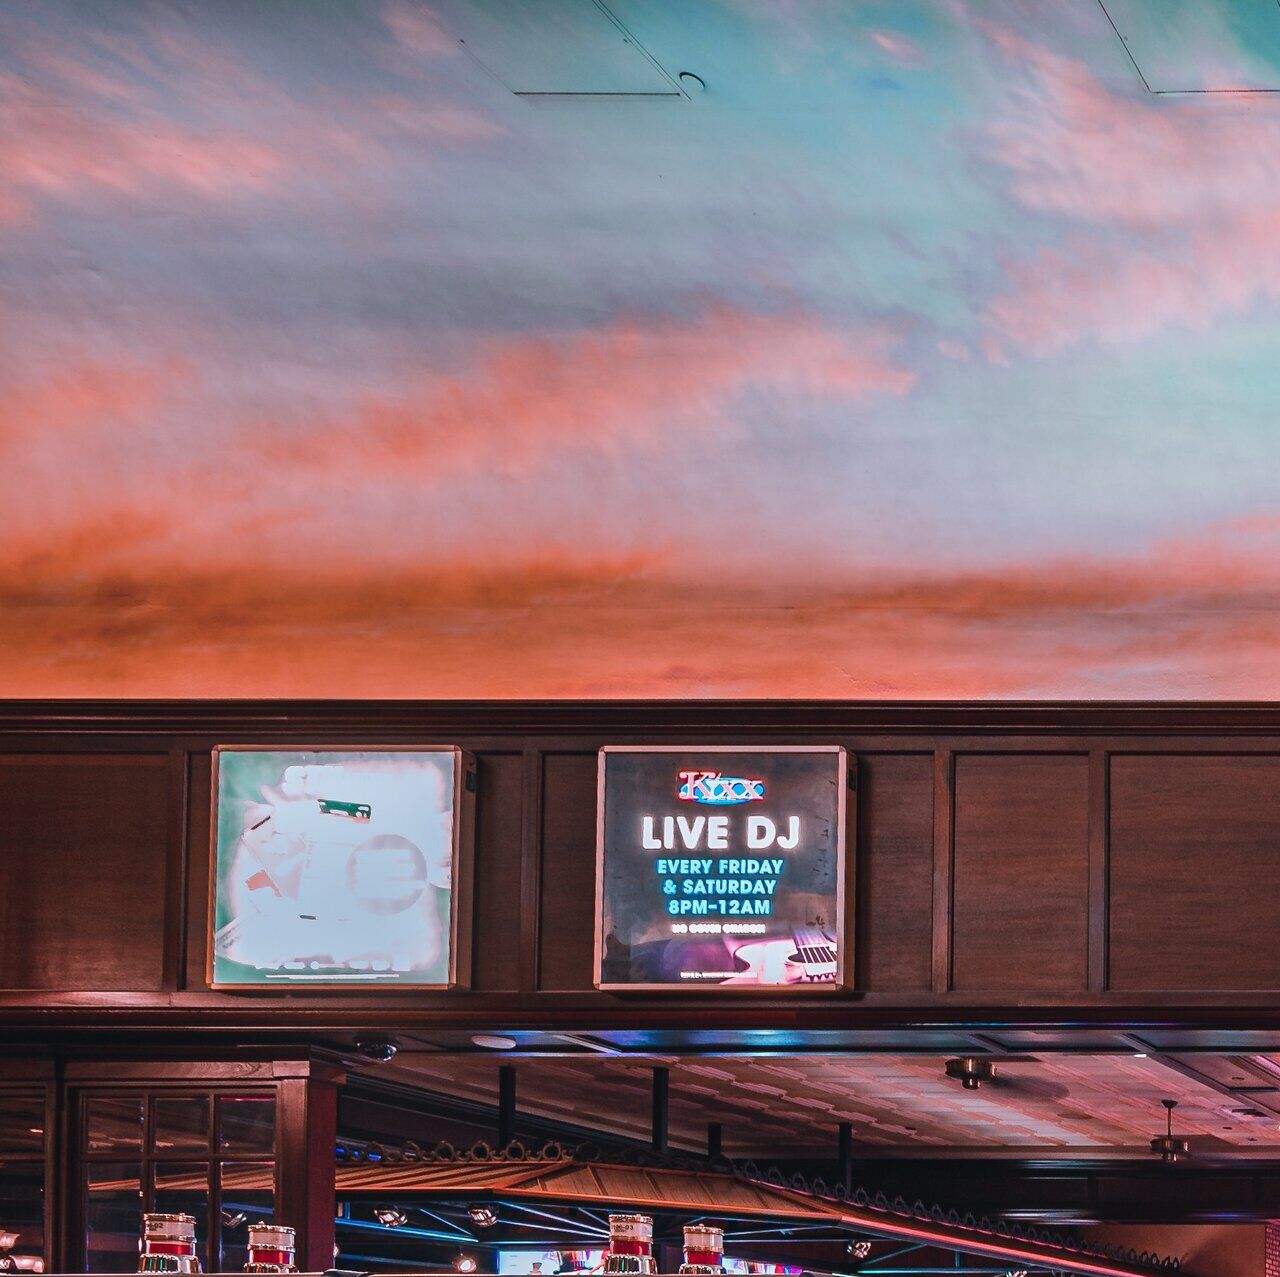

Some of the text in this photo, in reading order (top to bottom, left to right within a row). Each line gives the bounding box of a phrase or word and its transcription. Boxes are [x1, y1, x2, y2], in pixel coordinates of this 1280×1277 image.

[642, 815, 800, 850] LIVE DJ
[657, 859, 784, 874] EVERY FRIDAY
[663, 879, 776, 894] & SATURDAY
[668, 899, 771, 914] 8PM-12AM
